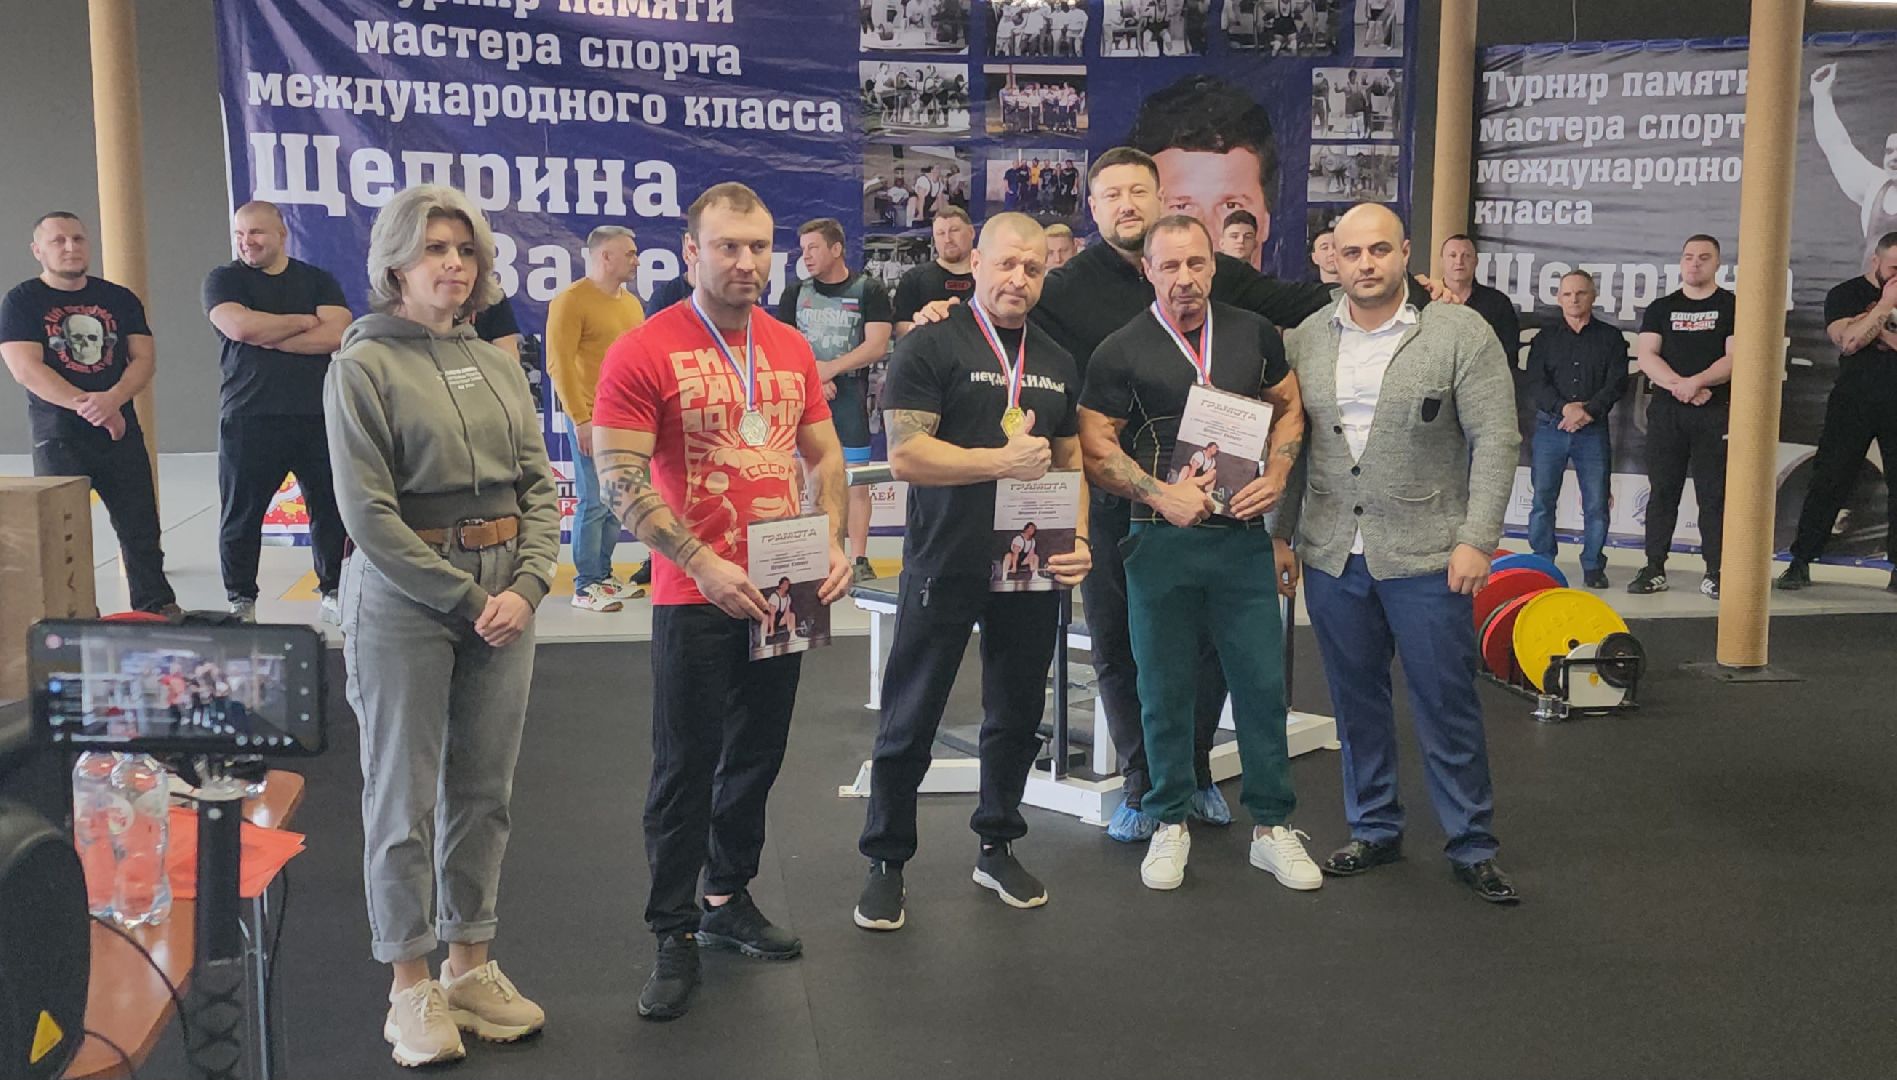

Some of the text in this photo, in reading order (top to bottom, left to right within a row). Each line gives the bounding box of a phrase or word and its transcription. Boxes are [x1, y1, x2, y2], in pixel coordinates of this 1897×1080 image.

[354, 20, 742, 80] мастера спорта
[247, 71, 845, 133] международного класса
[1482, 70, 1609, 107] Турнир
[1479, 114, 1625, 148] мастера
[1474, 200, 1593, 225] класса
[746, 463, 786, 478] СССР
[1010, 482, 1068, 491] ГРАМОТА
